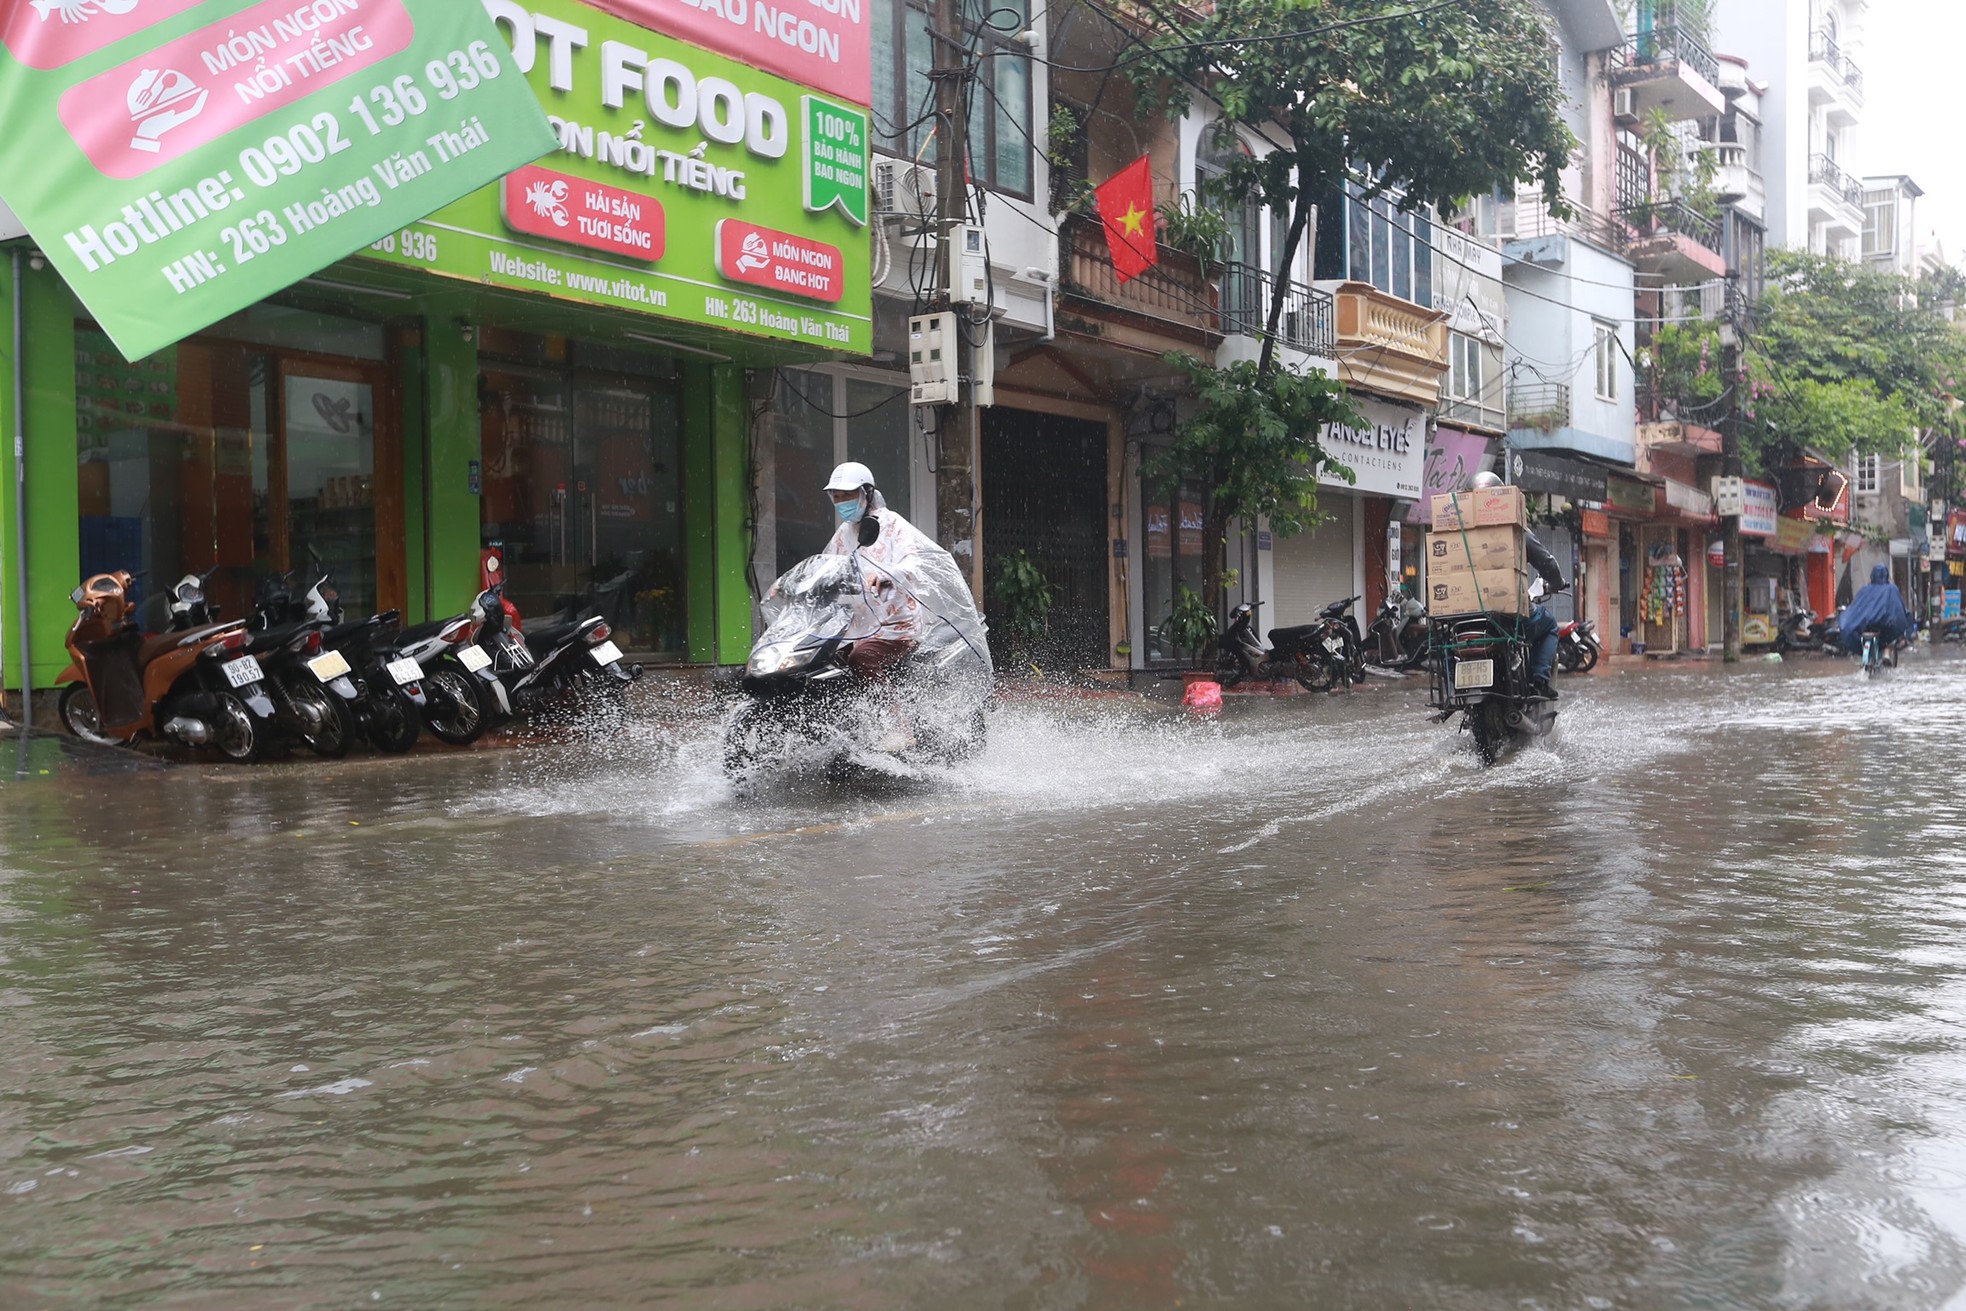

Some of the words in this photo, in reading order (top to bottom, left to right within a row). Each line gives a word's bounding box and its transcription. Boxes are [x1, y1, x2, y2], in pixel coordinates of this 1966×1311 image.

[201, 25, 277, 76] MÓN
[273, 0, 359, 42] NGON
[755, 1, 839, 63] NGON
[234, 56, 292, 105] NỔI
[285, 26, 374, 78] TIẾNG
[602, 40, 788, 158] FOOD
[816, 111, 860, 147] 100%
[63, 170, 245, 272] Hotline:
[239, 112, 352, 188] 0902
[348, 75, 428, 136] 136
[425, 40, 501, 100] 936
[597, 120, 655, 176] NỔI
[656, 141, 746, 200] TIẾNG
[814, 139, 834, 161] BẢO
[836, 148, 862, 169] HÀNH
[814, 162, 834, 181] BAO
[835, 166, 863, 190] NGON
[161, 249, 227, 294] HN:
[220, 210, 288, 264] 263
[283, 177, 382, 235] Hoàng
[372, 150, 432, 190] Văn
[426, 115, 490, 163] Thái
[585, 189, 609, 214] HẢI
[611, 195, 640, 221] SẢN
[401, 229, 437, 262] 936
[577, 215, 611, 240] TƯƠI
[613, 218, 651, 249] SỐNG
[773, 239, 800, 263] MÓN
[801, 248, 832, 270] NGON
[490, 250, 562, 286] Website:
[566, 271, 667, 308] www.vitot.vn
[775, 265, 806, 286] ĐANG
[807, 272, 831, 291] HOT
[706, 296, 728, 318] HN:
[732, 298, 757, 325] 263
[759, 308, 798, 336] Hoàng
[800, 315, 823, 338] Văn
[825, 321, 849, 343] Thái
[1378, 419, 1411, 453] EYES
[1341, 451, 1402, 472] CONTACTLENS
